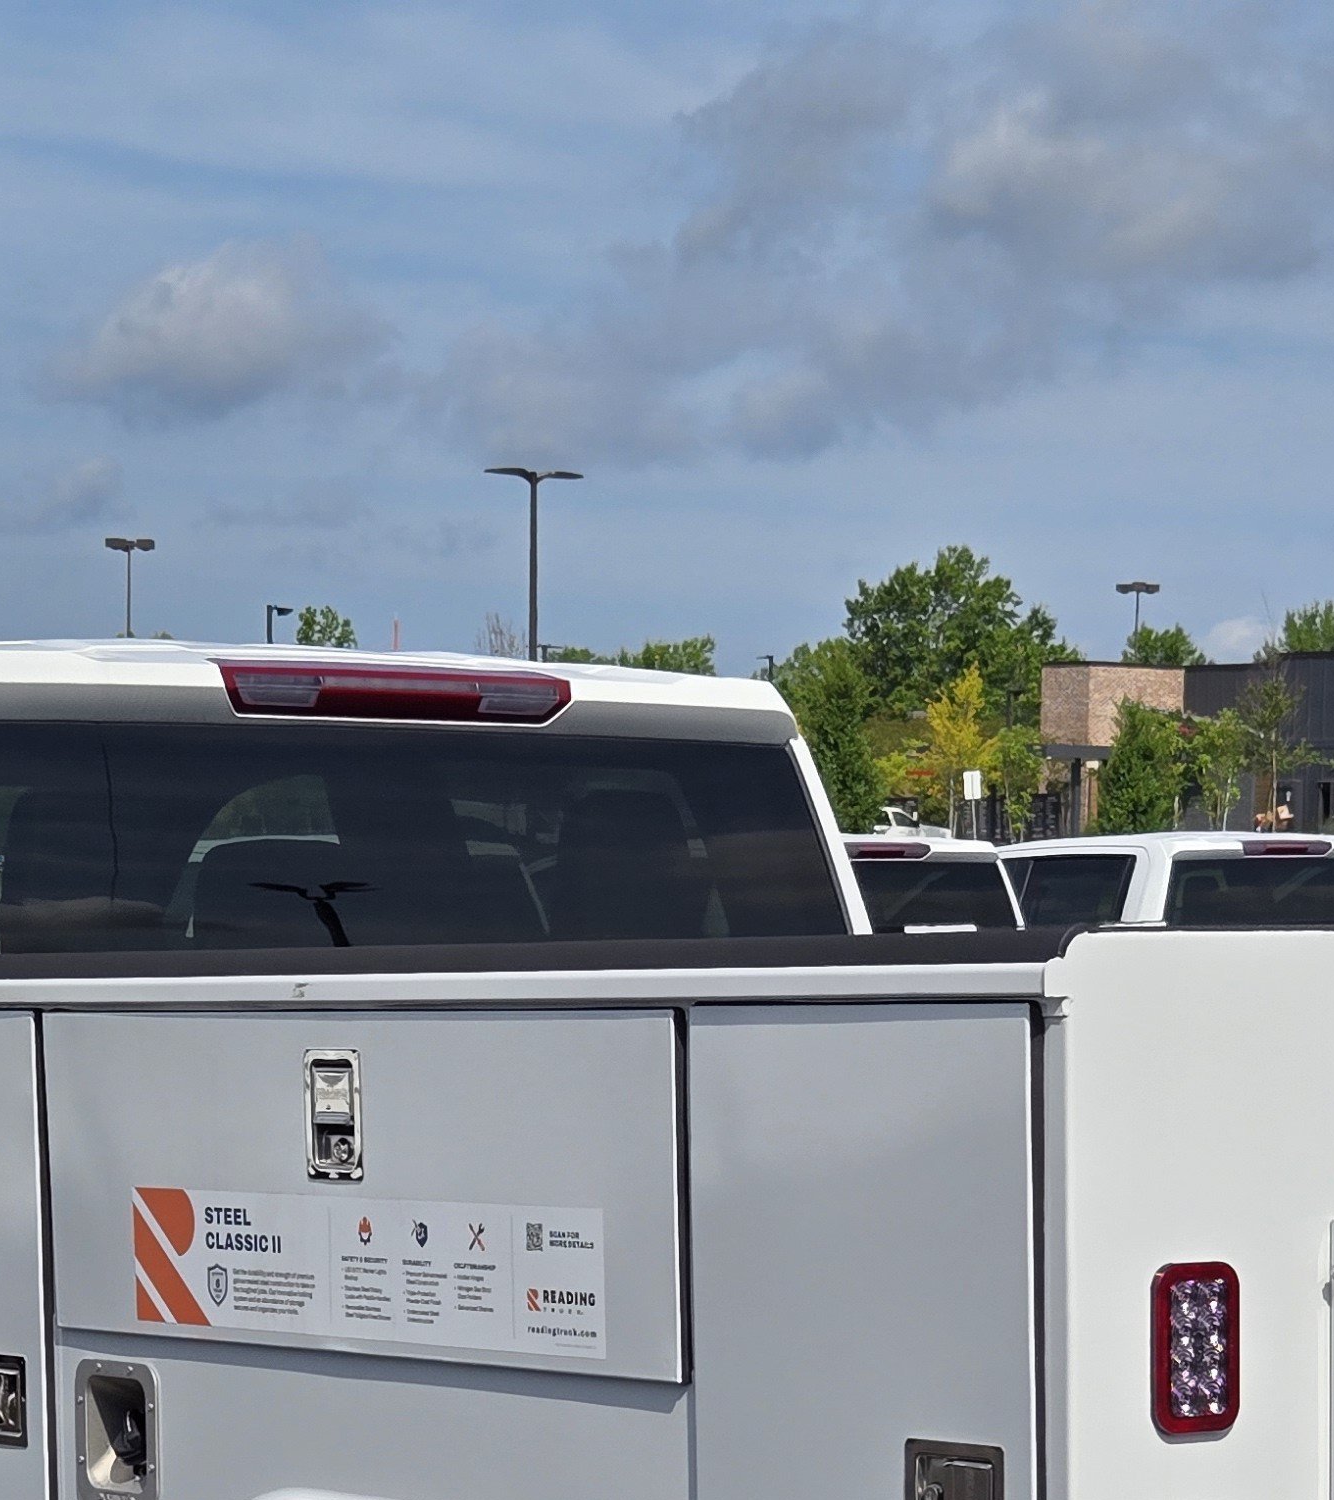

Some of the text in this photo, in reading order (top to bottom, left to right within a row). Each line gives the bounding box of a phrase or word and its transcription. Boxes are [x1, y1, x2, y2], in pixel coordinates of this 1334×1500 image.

[204, 1206, 252, 1226] STEEL
[205, 1231, 282, 1254] CLASSIC II
[542, 1289, 596, 1307] READING
[527, 1325, 598, 1339] readingtruck.com
